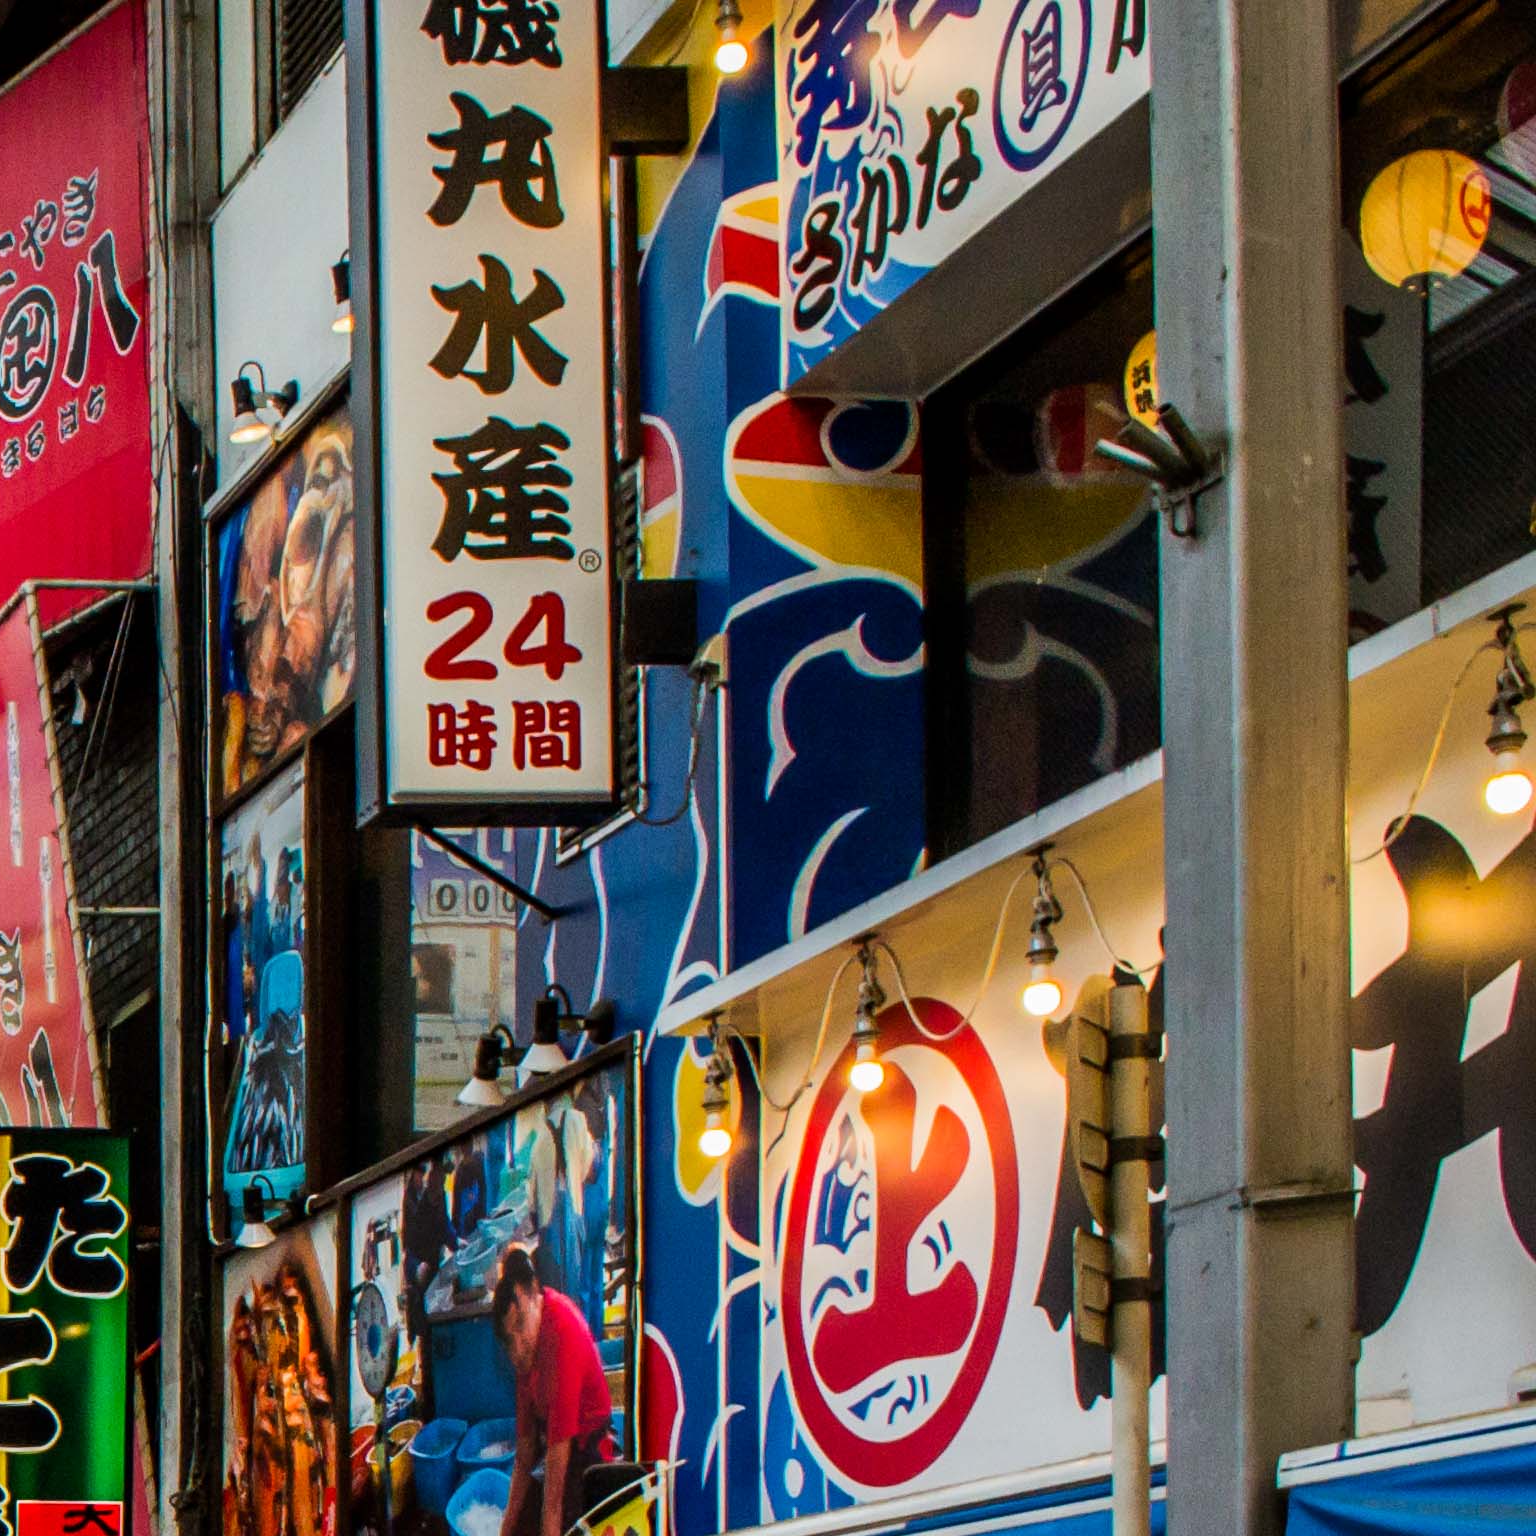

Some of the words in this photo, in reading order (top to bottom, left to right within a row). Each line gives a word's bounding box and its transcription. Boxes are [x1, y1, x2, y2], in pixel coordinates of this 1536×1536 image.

[792, 86, 983, 333] さかな
[57, 382, 107, 439] はち
[424, 591, 584, 682] 24
[426, 698, 584, 773] 時間
